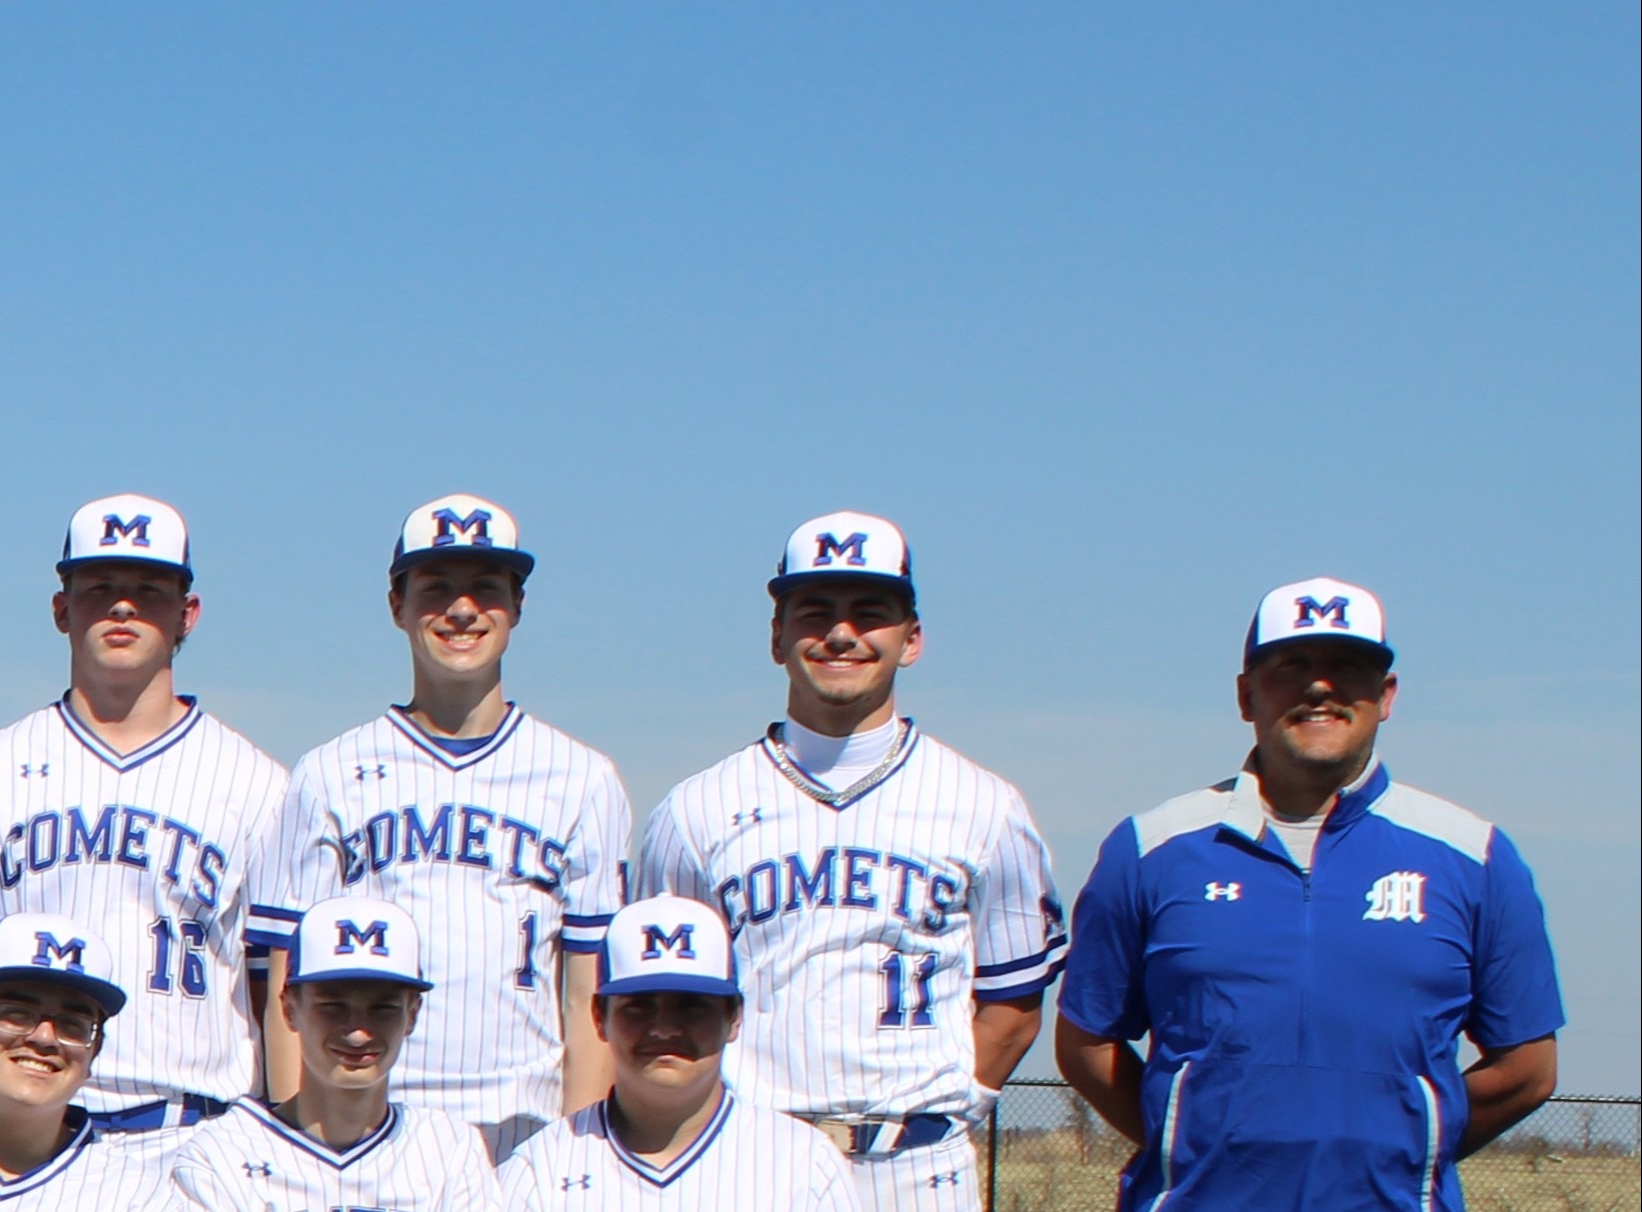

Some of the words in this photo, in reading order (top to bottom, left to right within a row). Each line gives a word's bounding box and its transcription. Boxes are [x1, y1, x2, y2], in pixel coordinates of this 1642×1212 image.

[99, 514, 151, 547] M
[432, 509, 493, 547] M
[813, 531, 867, 566] M
[1294, 596, 1349, 628] M
[0, 803, 226, 908] COMETS
[717, 848, 954, 937] COMETS
[1362, 870, 1426, 923] M
[32, 931, 85, 972] M
[147, 916, 208, 997] 16
[335, 919, 390, 955] M
[515, 911, 537, 990] 1
[641, 923, 697, 959] M
[879, 951, 937, 1030] 11
